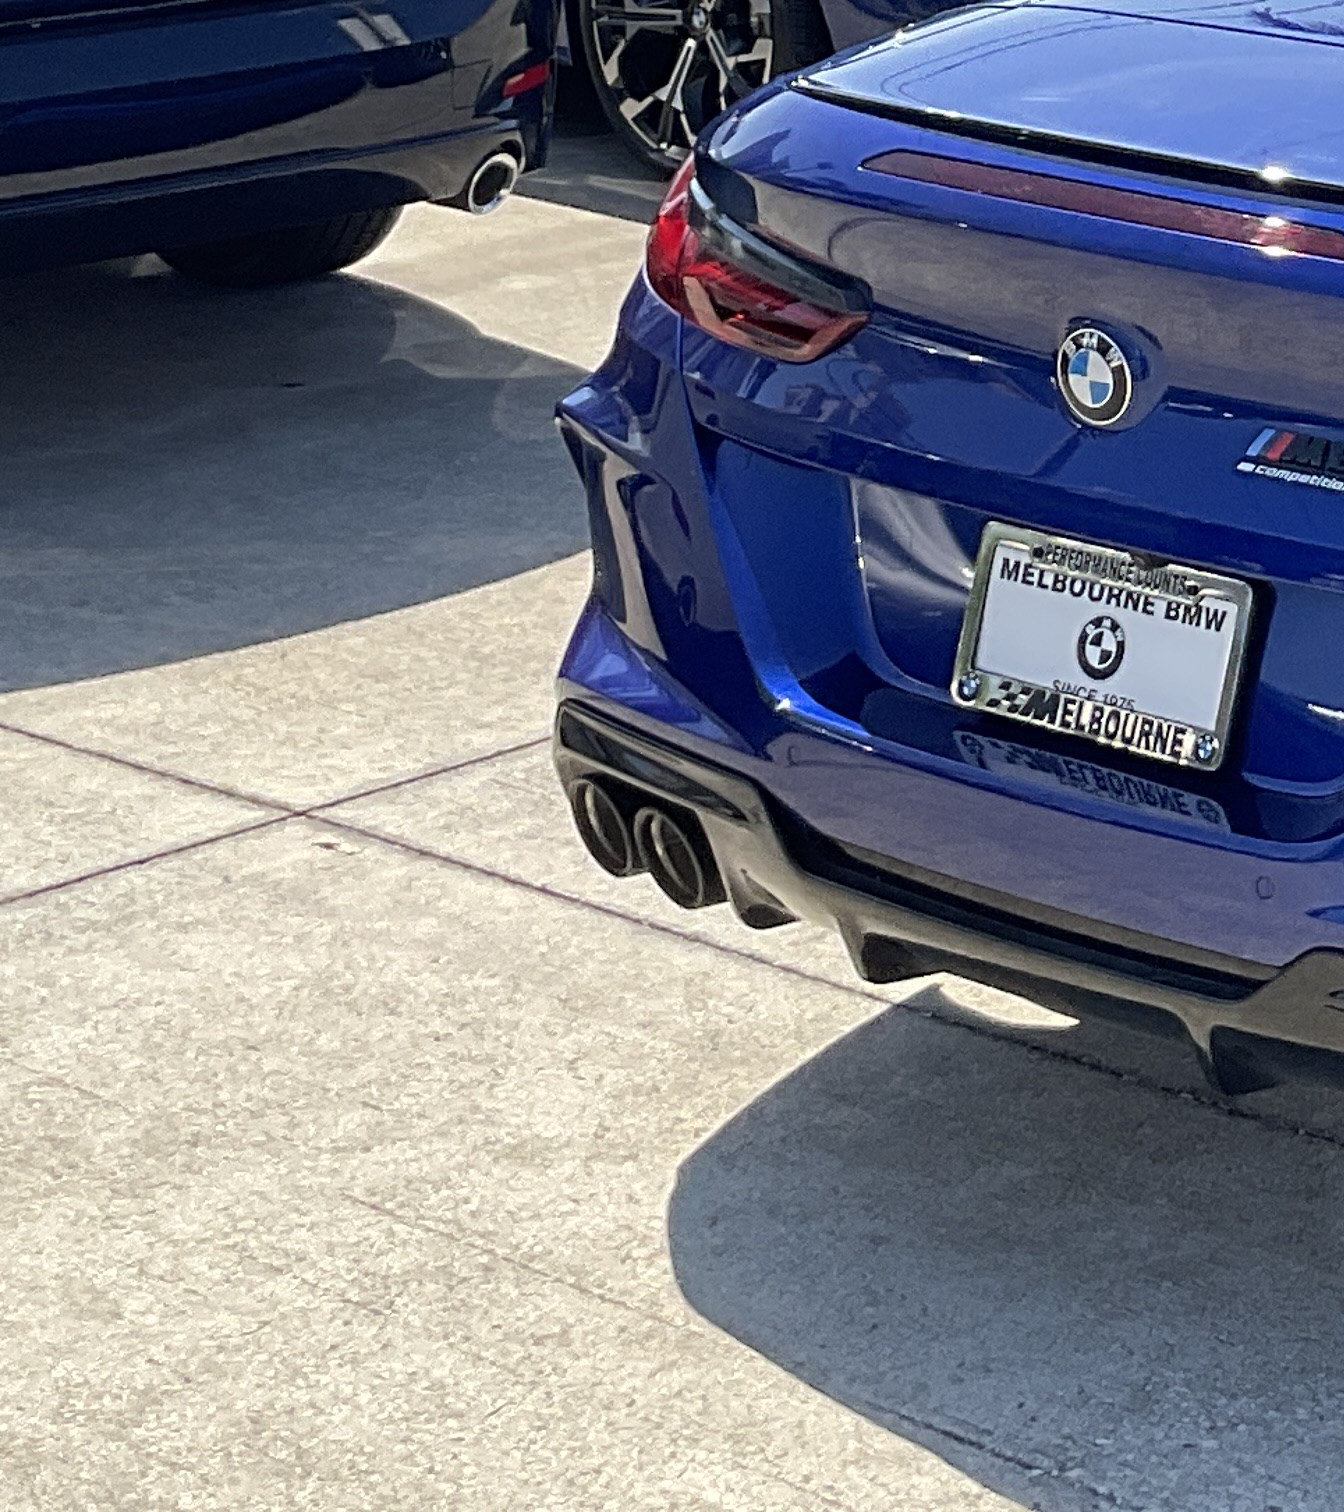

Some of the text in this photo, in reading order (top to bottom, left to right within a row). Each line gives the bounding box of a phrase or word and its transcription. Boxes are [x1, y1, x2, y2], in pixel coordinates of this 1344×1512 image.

[1045, 544, 1134, 583] PERFORMANCE
[1000, 558, 1227, 633] MELBOURNE BMW
[1052, 679, 1098, 700] SINCE
[1019, 689, 1188, 756] MELBOURNE
